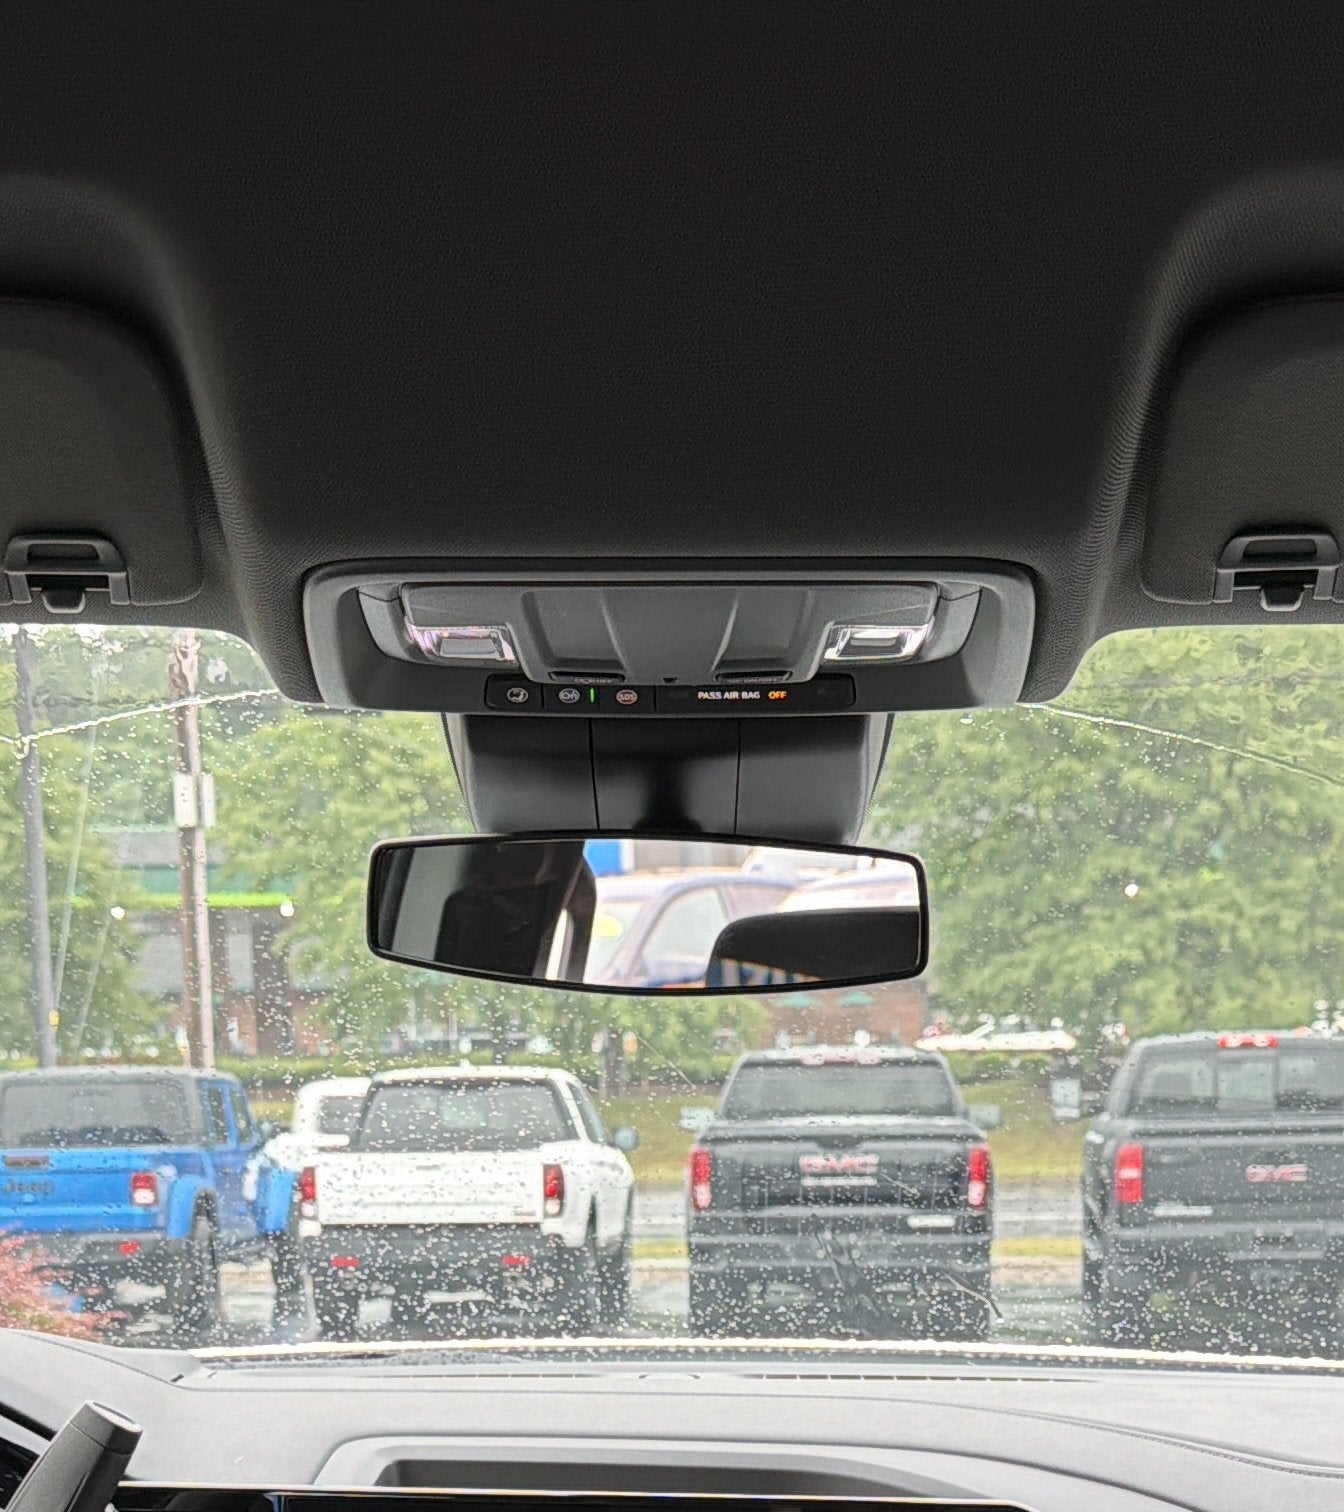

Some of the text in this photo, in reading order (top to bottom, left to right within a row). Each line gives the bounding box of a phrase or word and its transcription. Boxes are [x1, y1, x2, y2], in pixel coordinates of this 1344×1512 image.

[698, 690, 787, 700] PASS AIR BAG OFF
